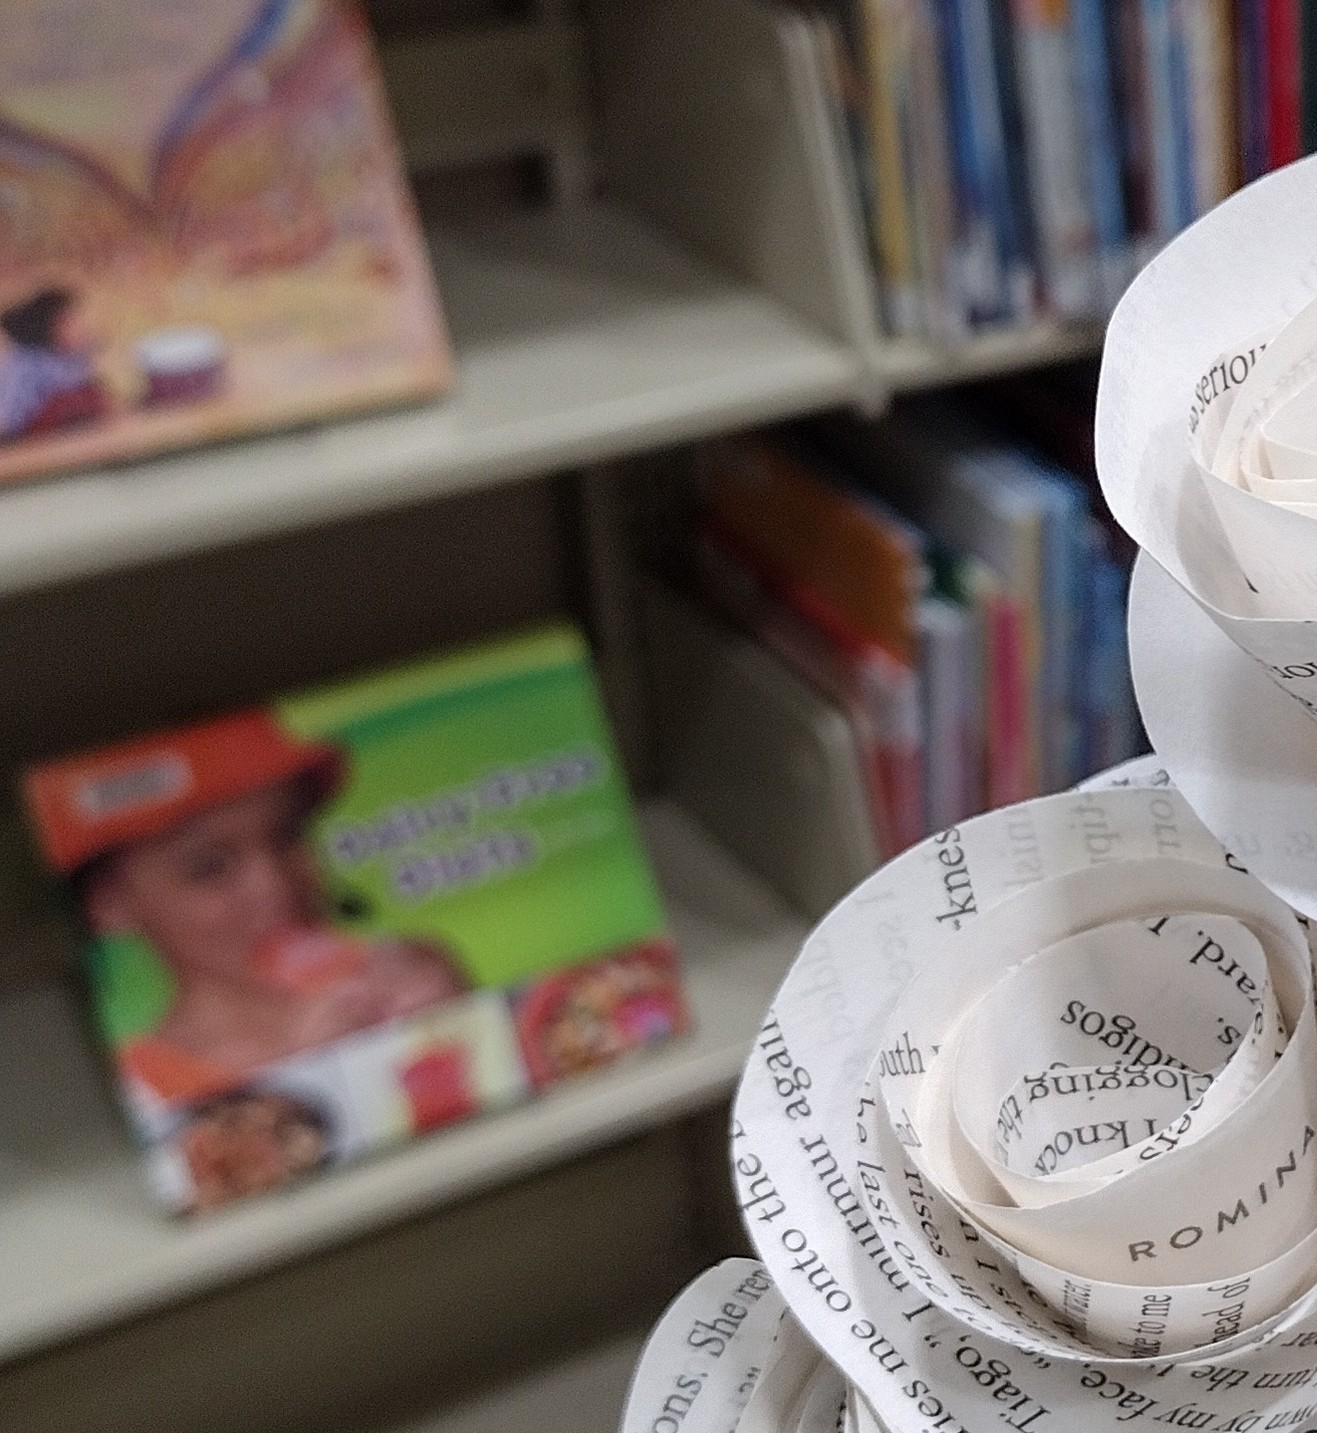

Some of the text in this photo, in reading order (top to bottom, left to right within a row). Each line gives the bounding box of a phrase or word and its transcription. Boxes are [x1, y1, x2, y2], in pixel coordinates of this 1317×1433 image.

[800, 1132, 911, 1294] murmur
[857, 1160, 900, 1231] last
[904, 1169, 951, 1260] rises
[1127, 1124, 1316, 1263] ROMINA
[737, 1152, 787, 1224] the
[780, 1228, 855, 1313] onto
[850, 1318, 908, 1374] me
[687, 1302, 749, 1359] She
[1080, 1362, 1159, 1422] face.
[1153, 1402, 1218, 1429] my
